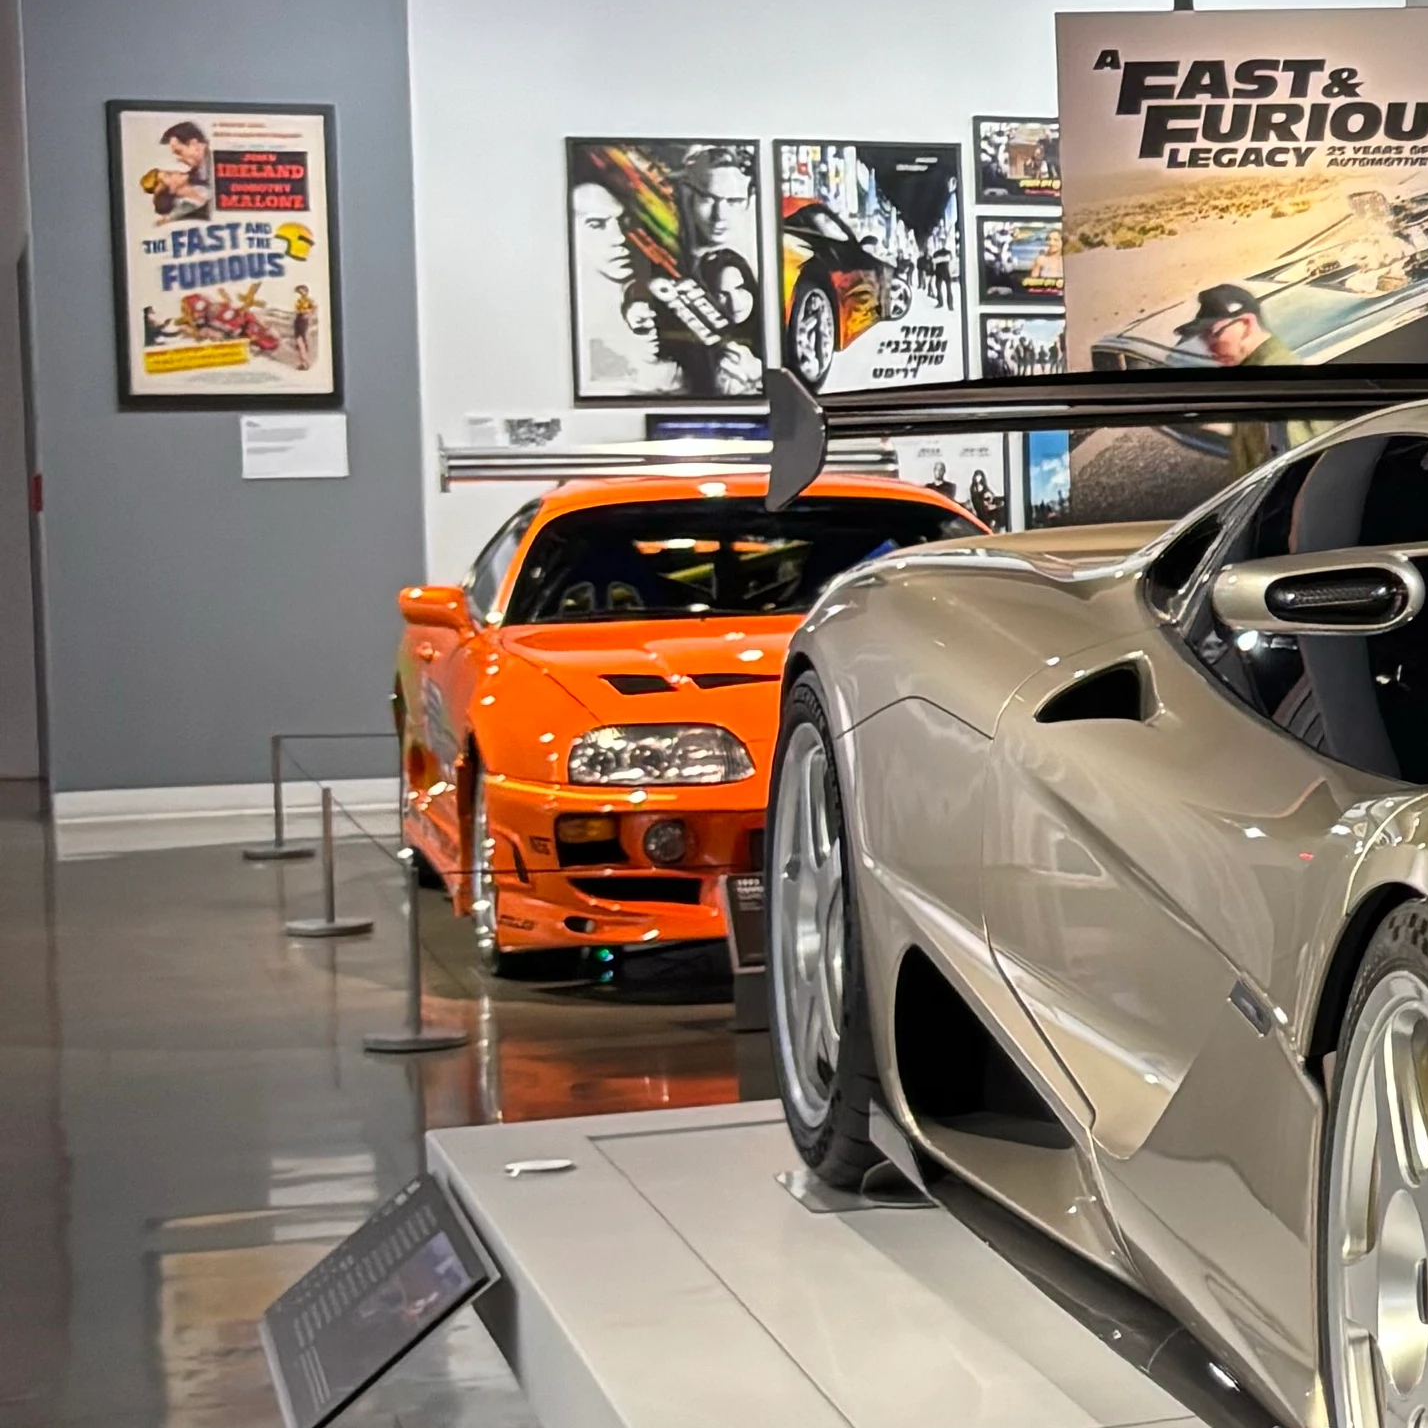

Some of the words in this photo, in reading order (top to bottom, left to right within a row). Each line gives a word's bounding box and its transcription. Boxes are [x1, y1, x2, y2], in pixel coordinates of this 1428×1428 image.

[1093, 49, 1121, 70] A
[1115, 59, 1326, 115] FAST
[1322, 67, 1364, 99] &
[1166, 146, 1317, 169] LEGACY
[1326, 145, 1346, 156] 25
[1353, 145, 1405, 156] YEARS
[216, 162, 304, 179] IRELAND
[1326, 156, 1428, 168] AUTOMOTIVE
[219, 194, 304, 209] MALONE
[244, 222, 272, 235] AND
[142, 239, 167, 254] THE
[171, 222, 242, 259] FAST
[246, 236, 272, 249] THE
[161, 252, 286, 292] FURIOUS
